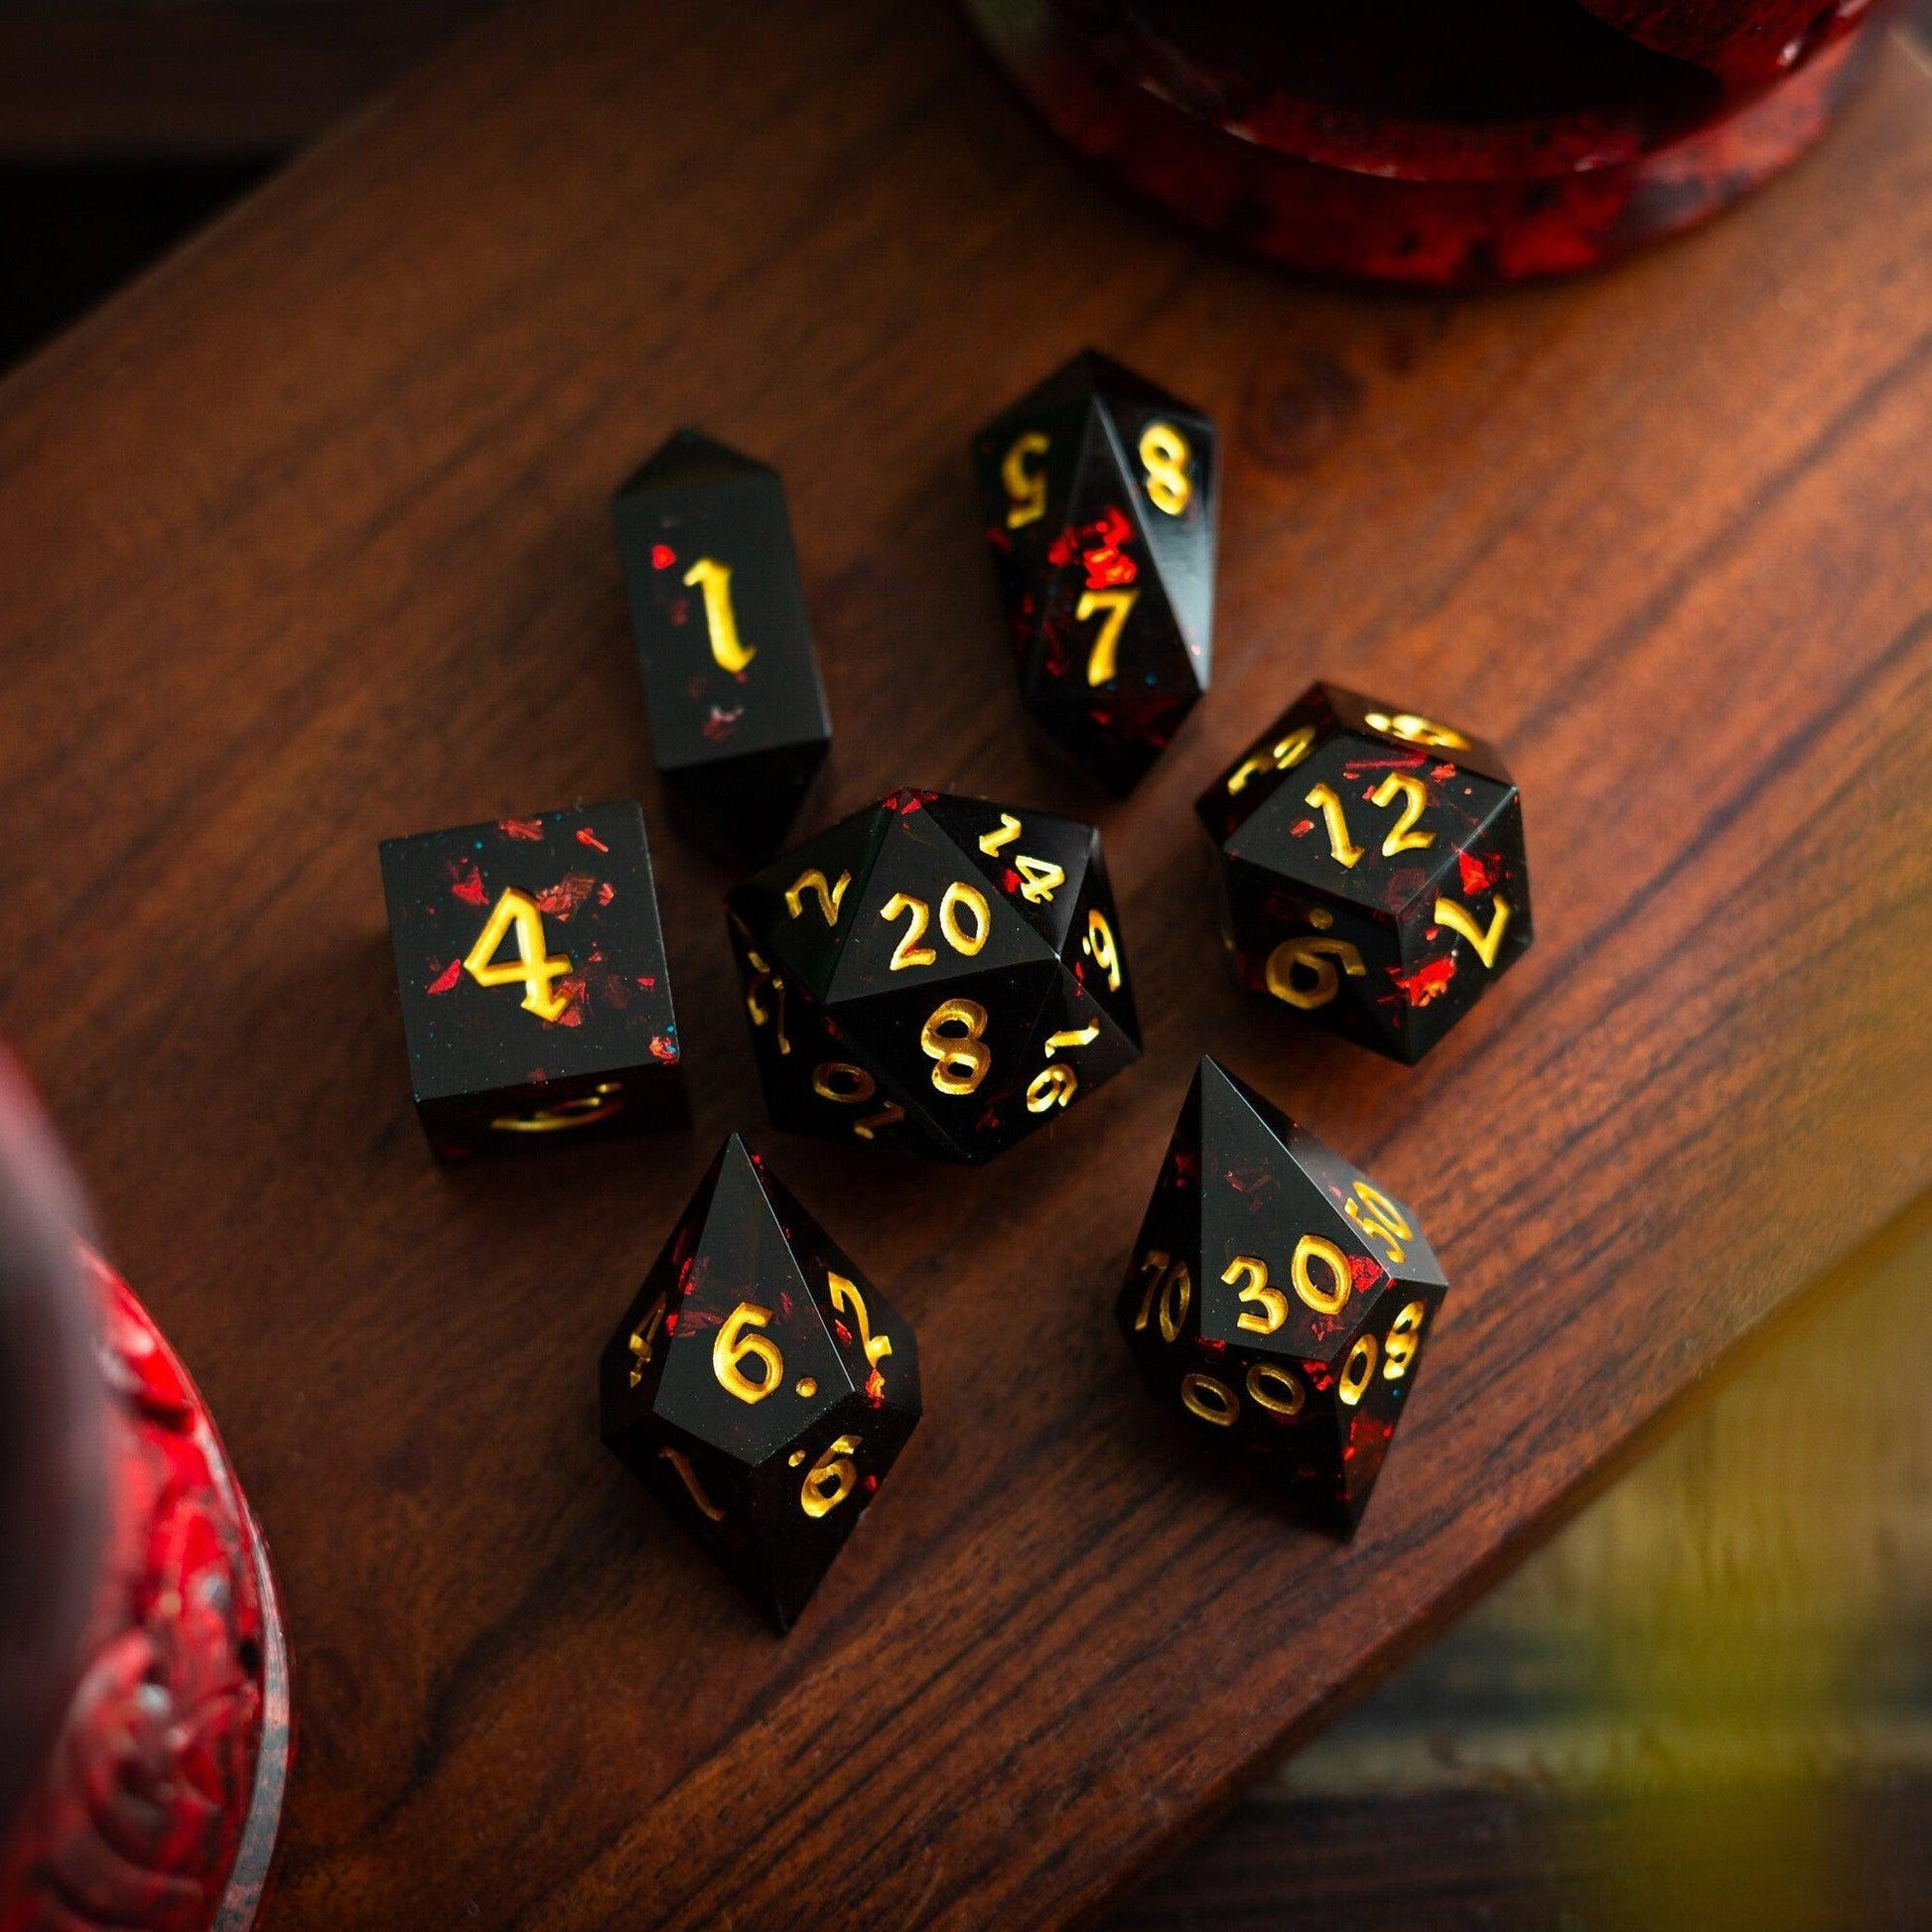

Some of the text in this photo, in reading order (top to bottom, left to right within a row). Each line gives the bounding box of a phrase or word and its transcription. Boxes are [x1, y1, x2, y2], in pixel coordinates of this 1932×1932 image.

[1139, 423, 1192, 515] 8
[683, 558, 757, 674] 1
[1075, 589, 1140, 687] 7
[979, 813, 1066, 904] 14
[1305, 771, 1437, 869] 12
[784, 868, 852, 926] 2
[880, 881, 992, 971] 20
[1434, 895, 1512, 969] 7
[463, 886, 574, 1023] 4
[919, 998, 993, 1095] 8
[1344, 1180, 1414, 1265] 50
[827, 1271, 893, 1368] 2
[1135, 1249, 1191, 1343] 70
[1221, 1233, 1353, 1334] 30
[1179, 1361, 1307, 1428] 00
[1338, 1299, 1427, 1406] 80
